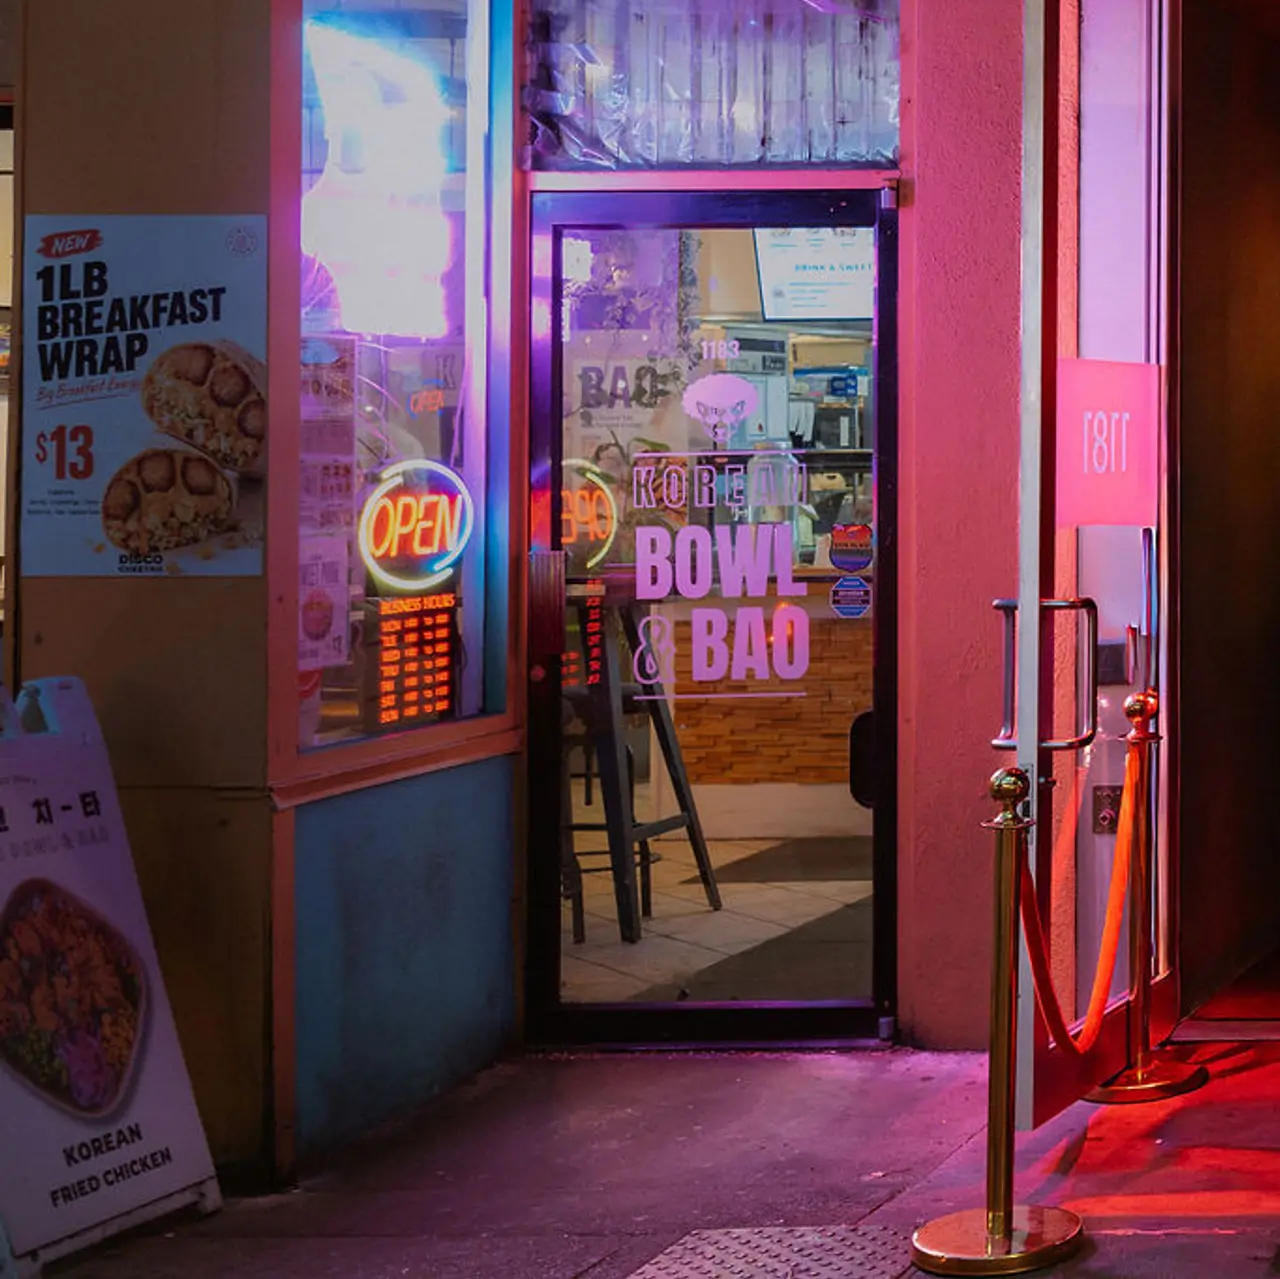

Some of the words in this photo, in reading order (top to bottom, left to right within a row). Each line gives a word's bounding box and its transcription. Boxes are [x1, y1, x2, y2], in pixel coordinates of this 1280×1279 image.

[51, 232, 90, 256] NEW
[36, 261, 108, 302] 1LB
[37, 287, 226, 341] BREAKFAST
[37, 332, 149, 382] WRAP
[702, 339, 741, 361] 1183
[35, 423, 94, 480] $13
[632, 462, 808, 509] KOREAN
[367, 493, 463, 559] OPEN
[634, 523, 808, 601] BOWL
[633, 615, 677, 685] &
[690, 606, 811, 682] BAO
[62, 1122, 144, 1168] KOREAN
[50, 1174, 101, 1209] FRIED
[102, 1146, 173, 1188] CHICKEN
